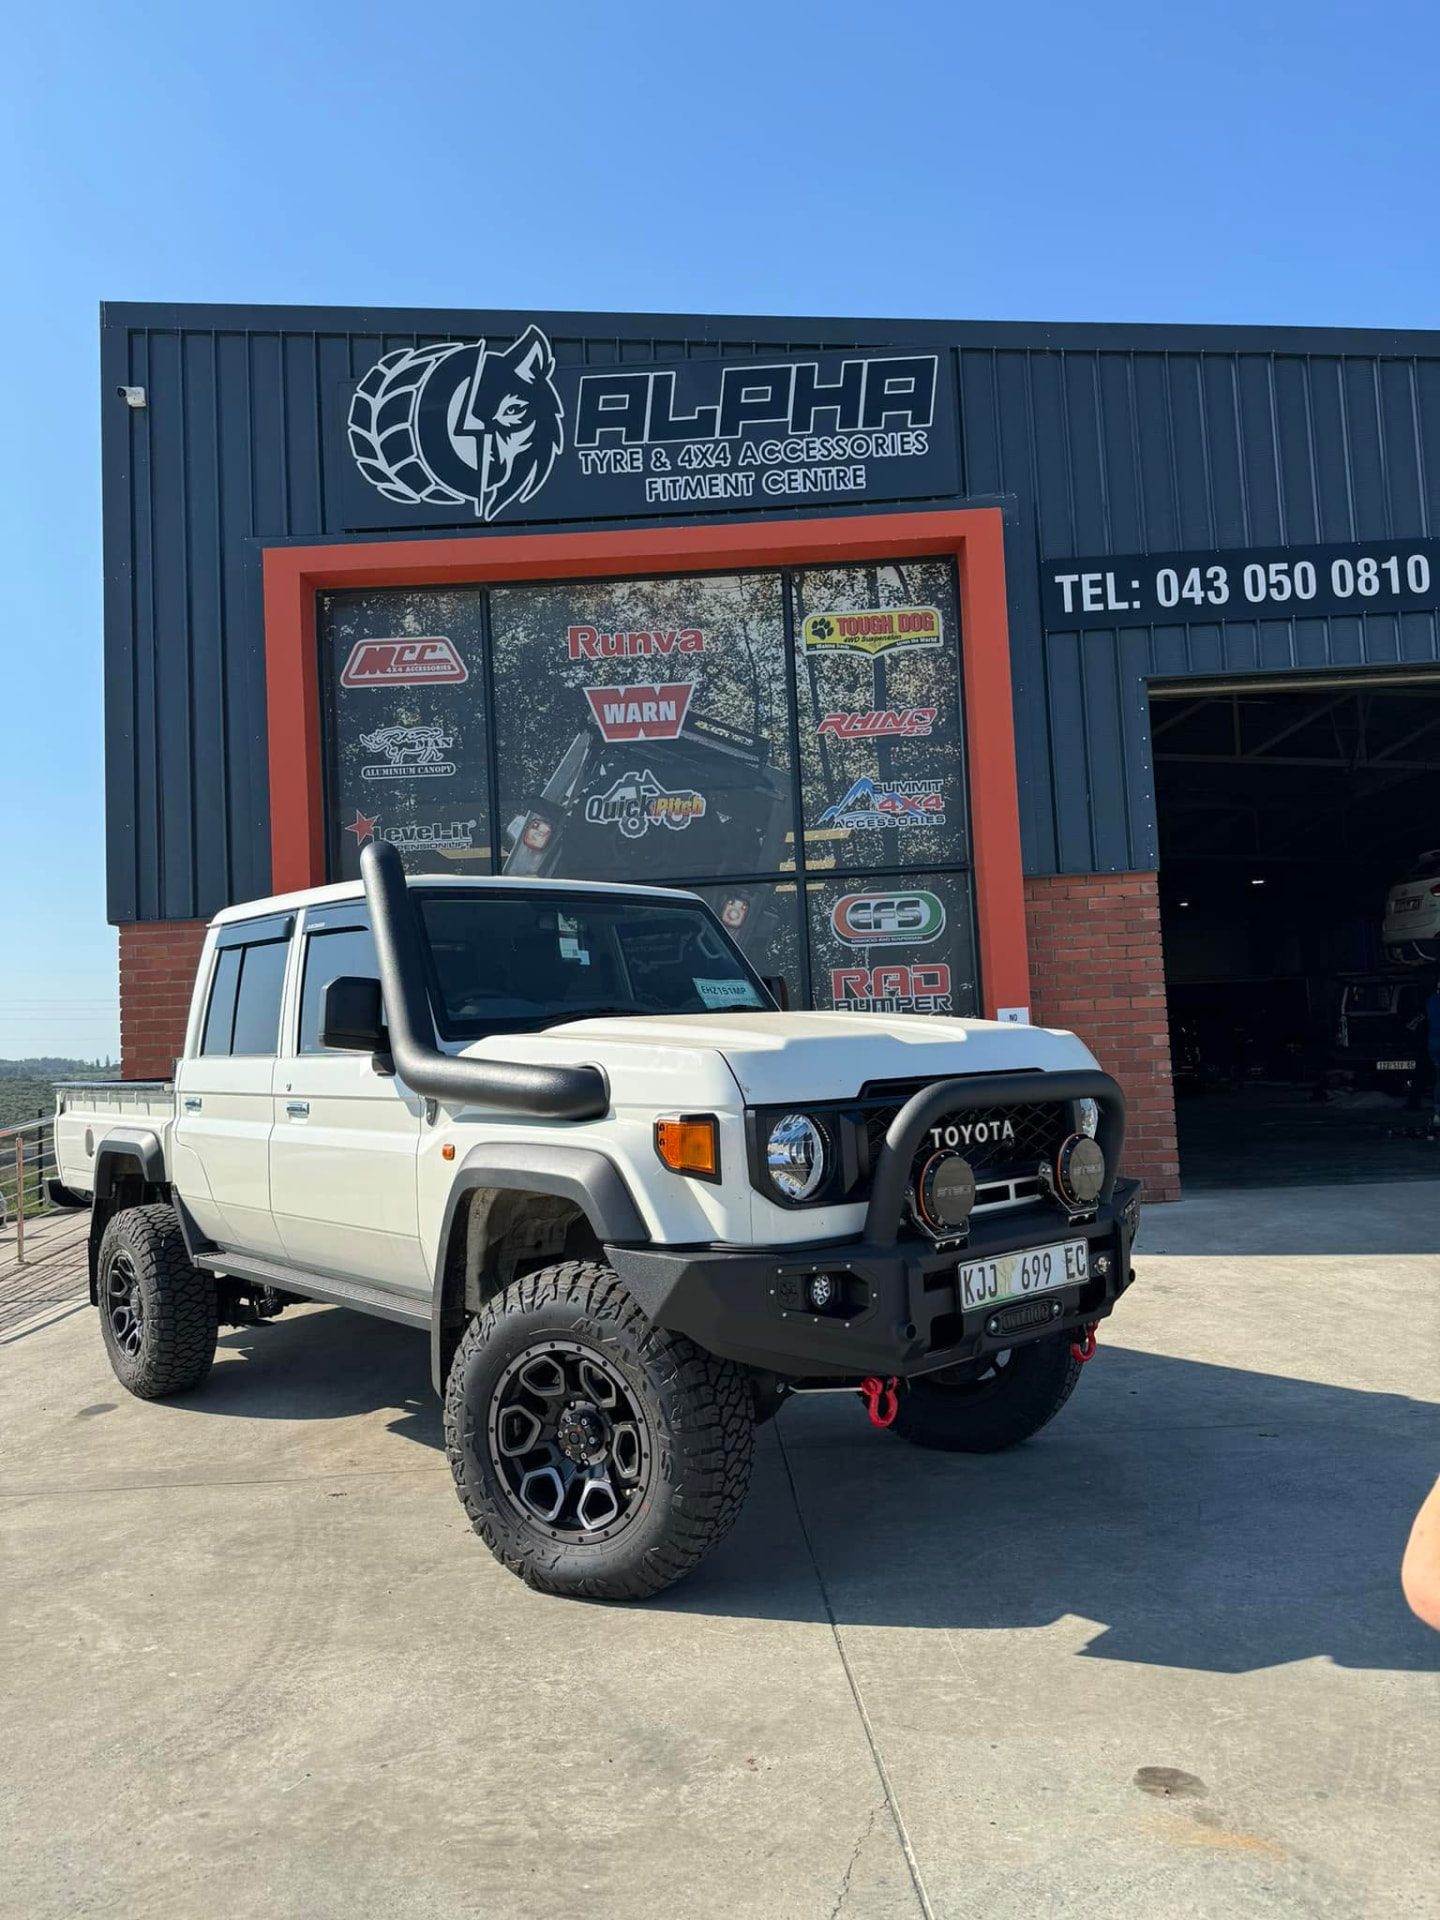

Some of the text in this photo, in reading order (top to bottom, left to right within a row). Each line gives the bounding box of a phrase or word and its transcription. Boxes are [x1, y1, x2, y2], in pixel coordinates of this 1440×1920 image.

[575, 355, 939, 447] ALPHA
[578, 431, 930, 474] TYRE & 4X4 ACCESSORIES
[646, 465, 867, 502] FITMENT CENTRE
[1055, 554, 1430, 613] TEL: 043 050 0810
[837, 612, 935, 637] TOUGH DOG
[568, 626, 704, 658] Runva
[405, 664, 452, 673] ACCESSORIES
[603, 700, 677, 725] WARN
[816, 708, 937, 739] RHINO
[416, 737, 453, 749] MAN
[365, 765, 452, 777] ALUMINIUM CANOPY
[873, 780, 944, 795] SUMMIT
[877, 794, 944, 812] 4X4
[833, 815, 945, 830] ACCESSORIES
[848, 899, 923, 930] EFS
[832, 963, 951, 1000] RAD
[931, 1120, 1014, 1147] TOYOTA
[963, 1244, 1086, 1306] KJJ 699 EC
